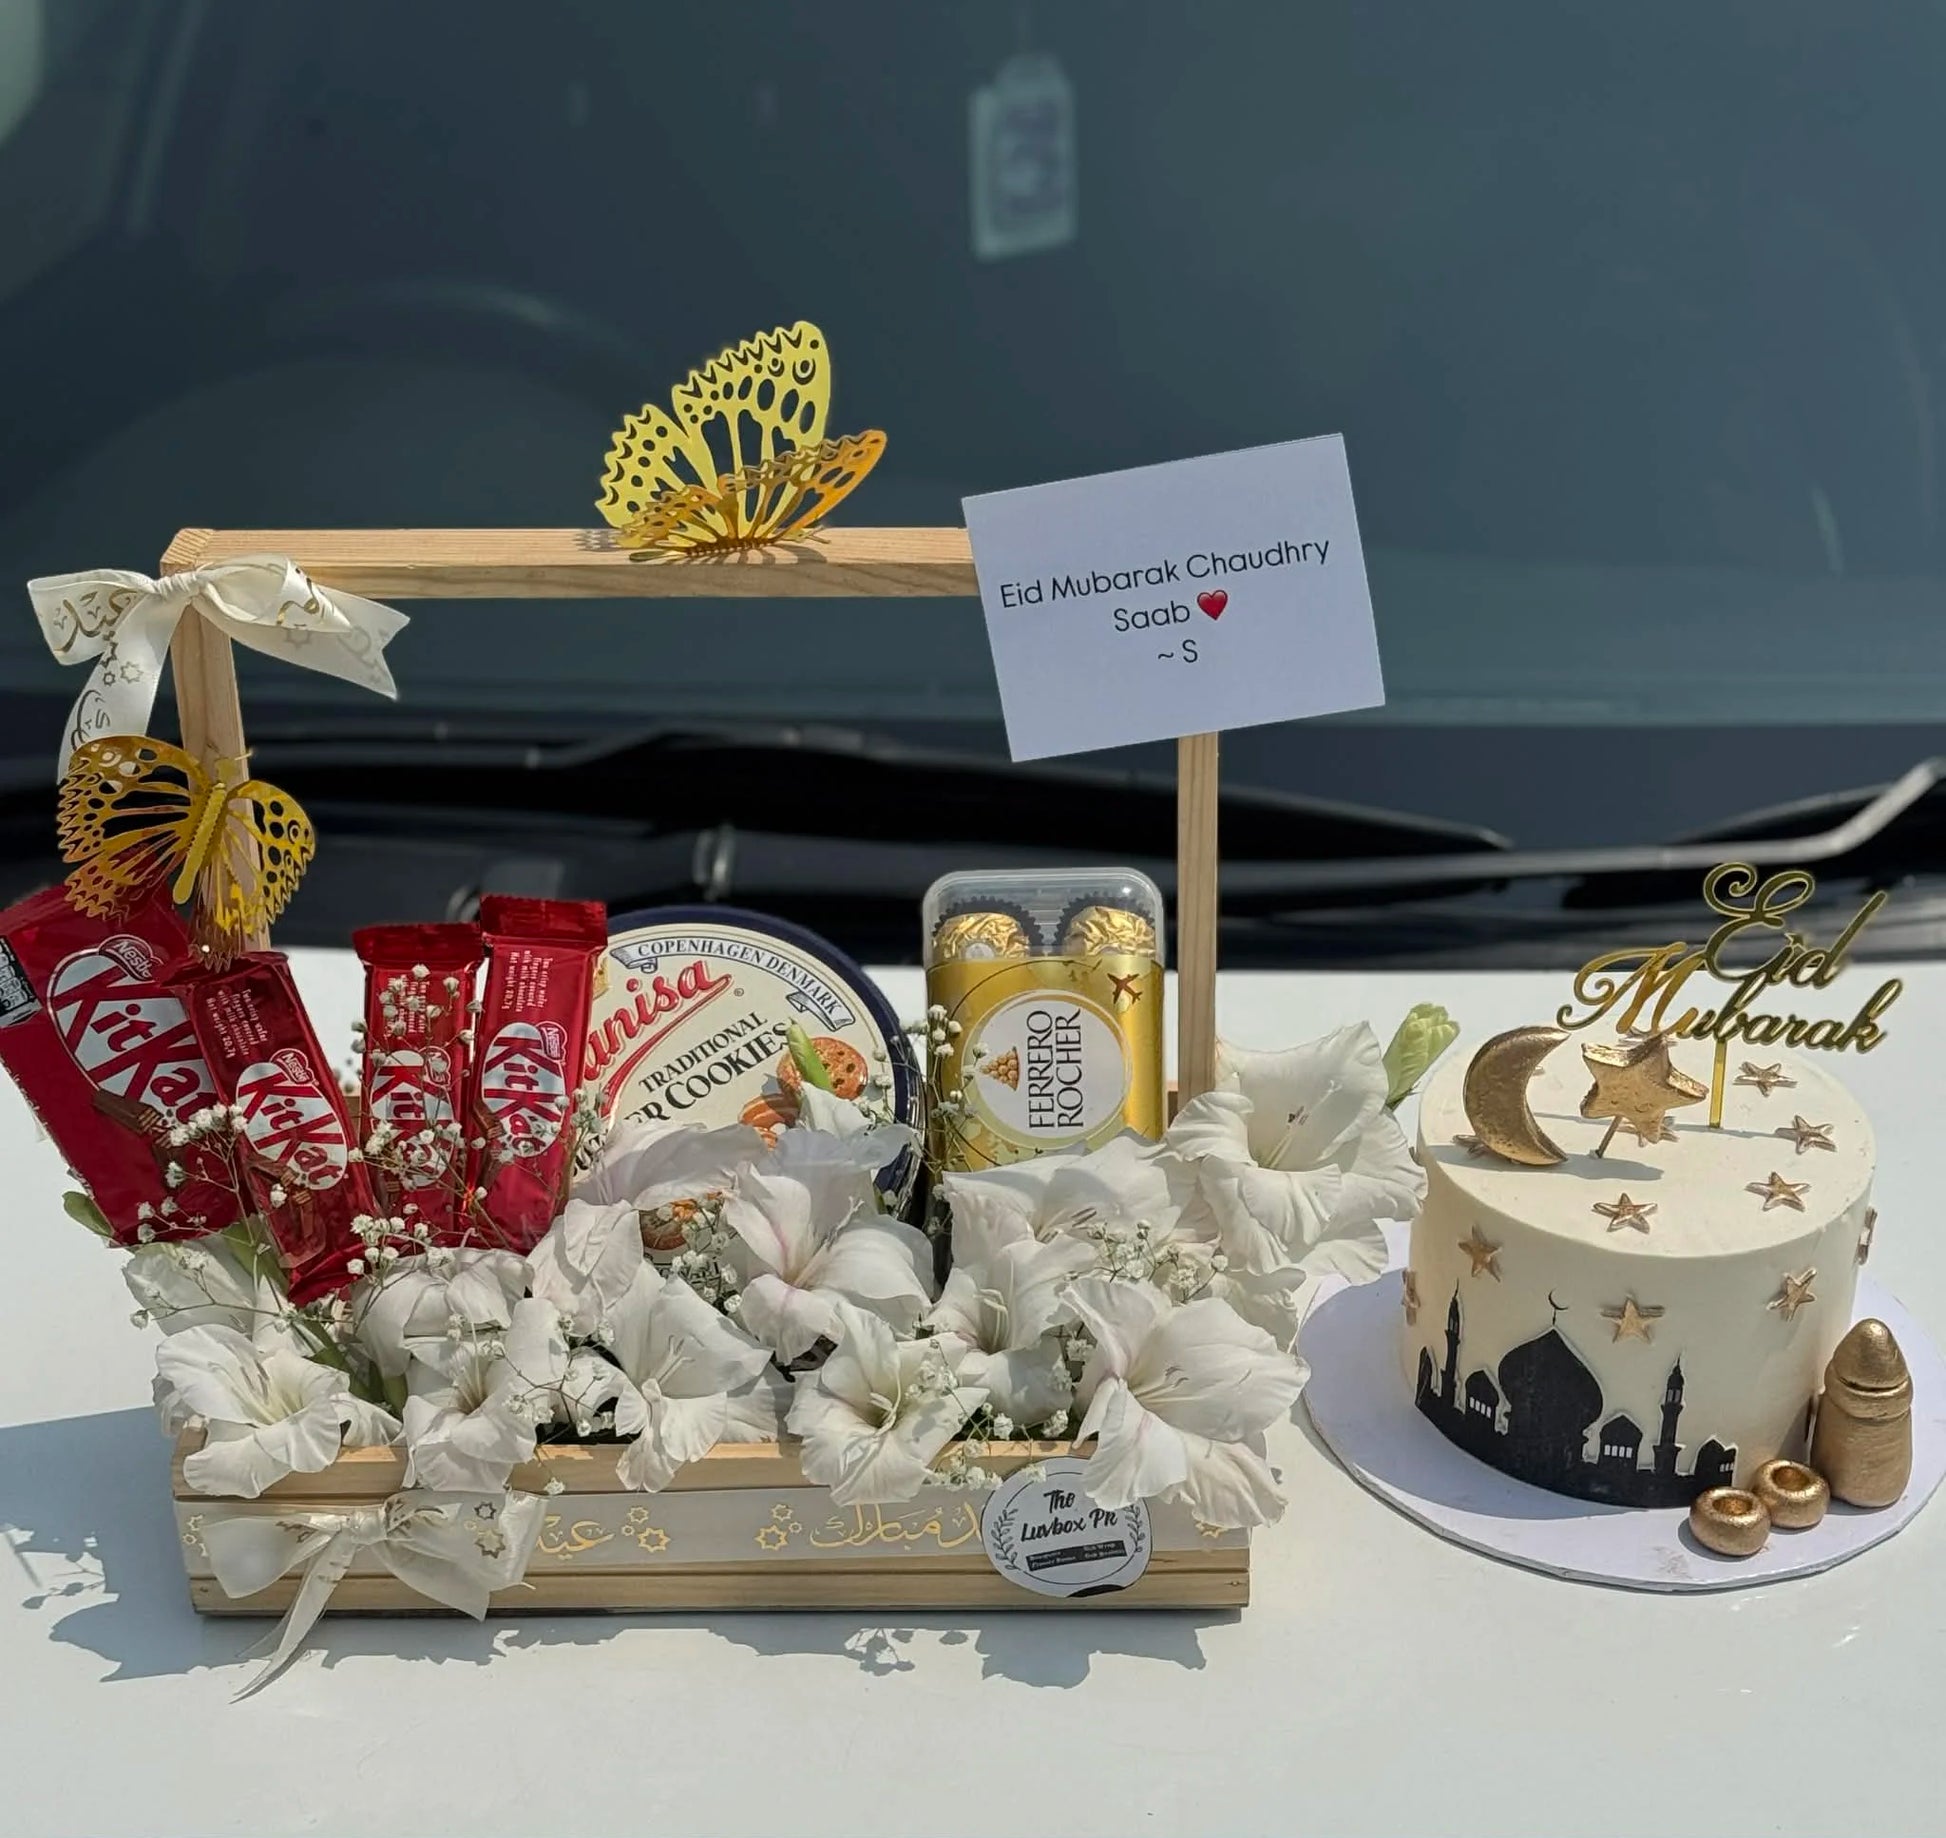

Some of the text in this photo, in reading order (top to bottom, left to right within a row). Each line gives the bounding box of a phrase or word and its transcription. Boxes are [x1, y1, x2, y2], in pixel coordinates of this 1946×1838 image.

[1000, 540, 1331, 609] Eid Mubarak Chaudhry
[1113, 600, 1191, 632] Saab
[1181, 639, 1199, 664] S
[1703, 861, 1888, 990] Eid
[584, 959, 716, 1081] anisa
[637, 938, 843, 1016] COPENHAGEN DENMARK
[1556, 941, 1903, 1054] Mubarak
[484, 1037, 563, 1152] KitKat
[638, 1011, 769, 1094] TRADITIONAL
[664, 1021, 790, 1109] COOKIES
[1026, 1009, 1055, 1129] FERRERO
[1055, 1008, 1084, 1128] ROCHER
[238, 1071, 344, 1185] KitKat
[1020, 1515, 1087, 1542] Luvbox
[1043, 1488, 1076, 1514] The
